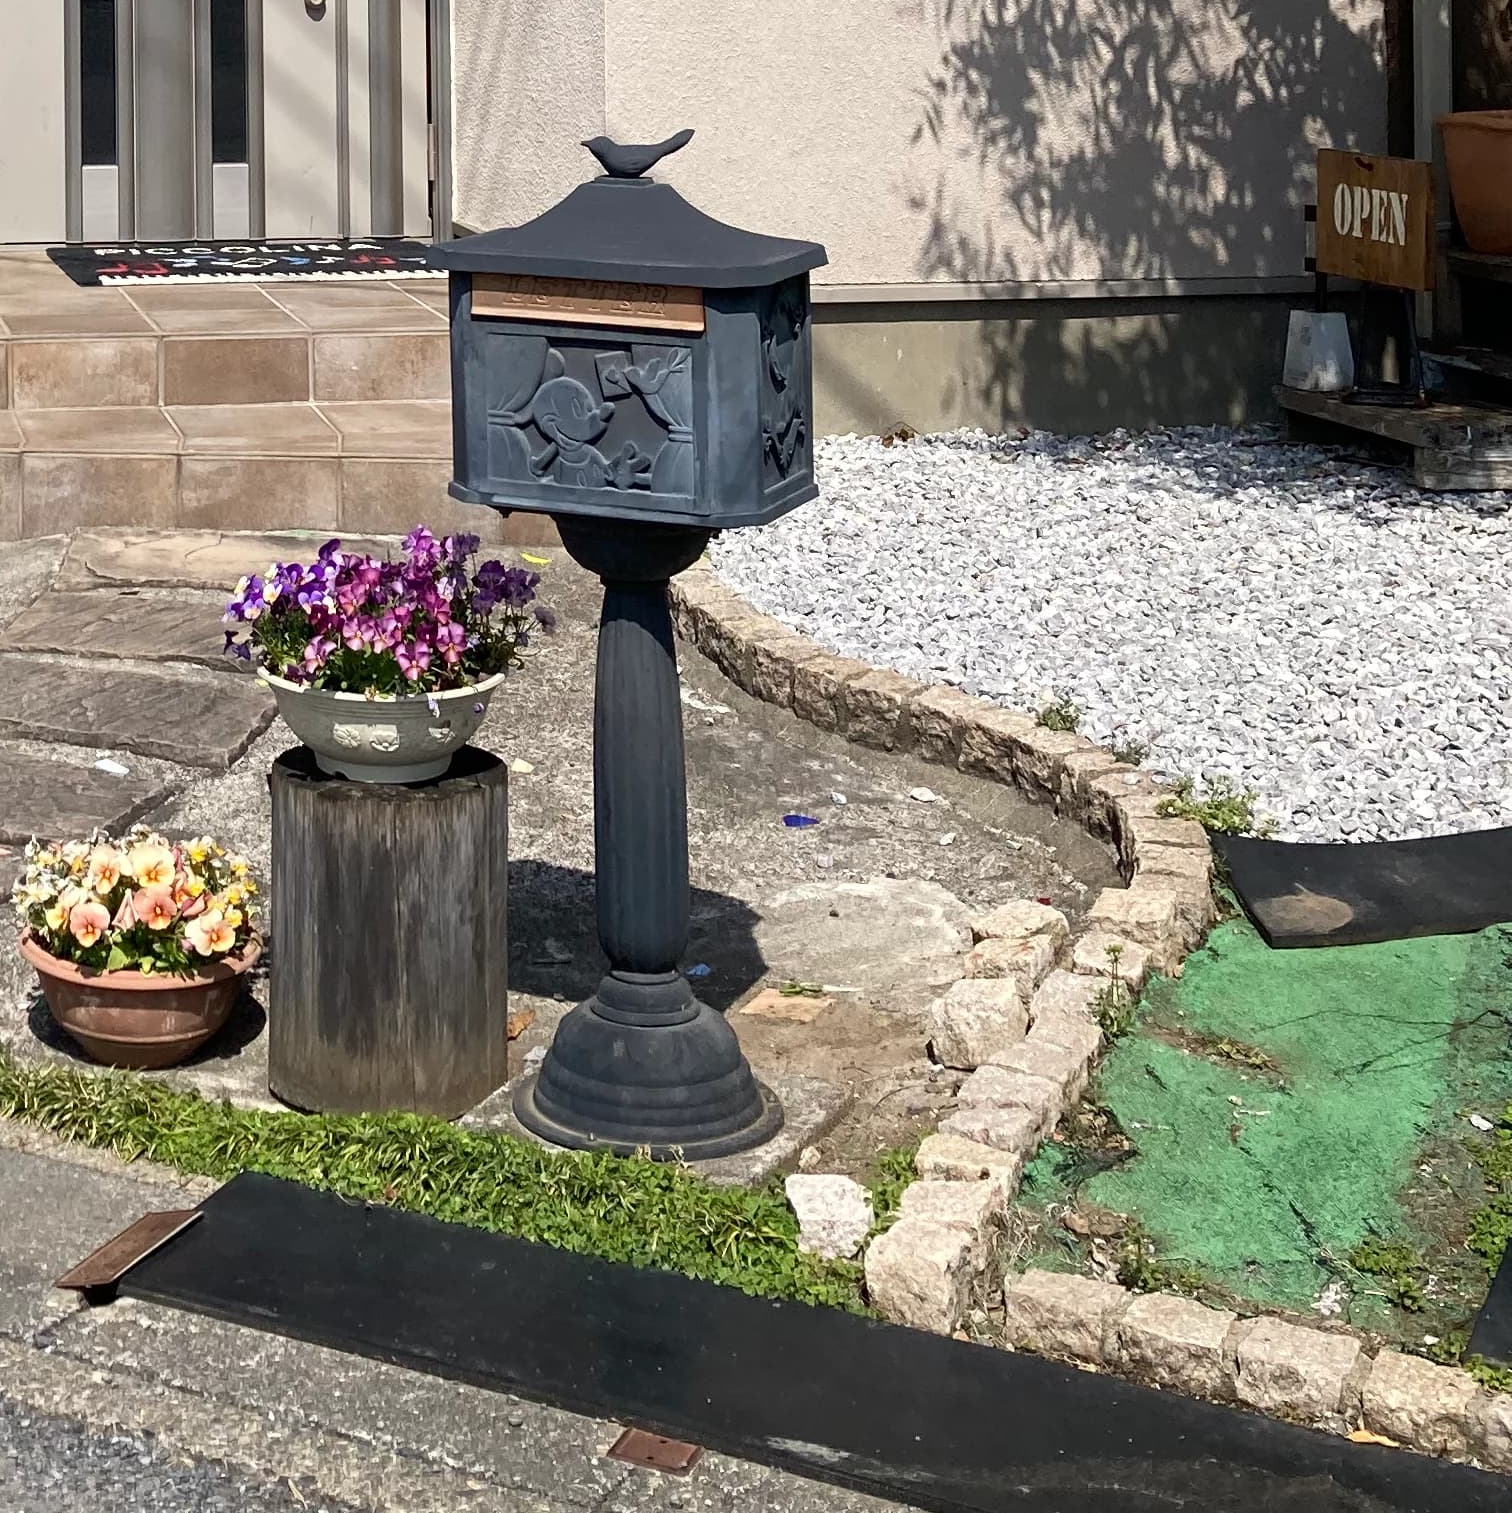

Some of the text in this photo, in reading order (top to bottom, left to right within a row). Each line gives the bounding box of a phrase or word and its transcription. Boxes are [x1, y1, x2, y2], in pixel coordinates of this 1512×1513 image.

[1333, 183, 1409, 247] OPEN
[93, 243, 384, 256] PICCOLINA
[501, 274, 665, 318] LETTER
